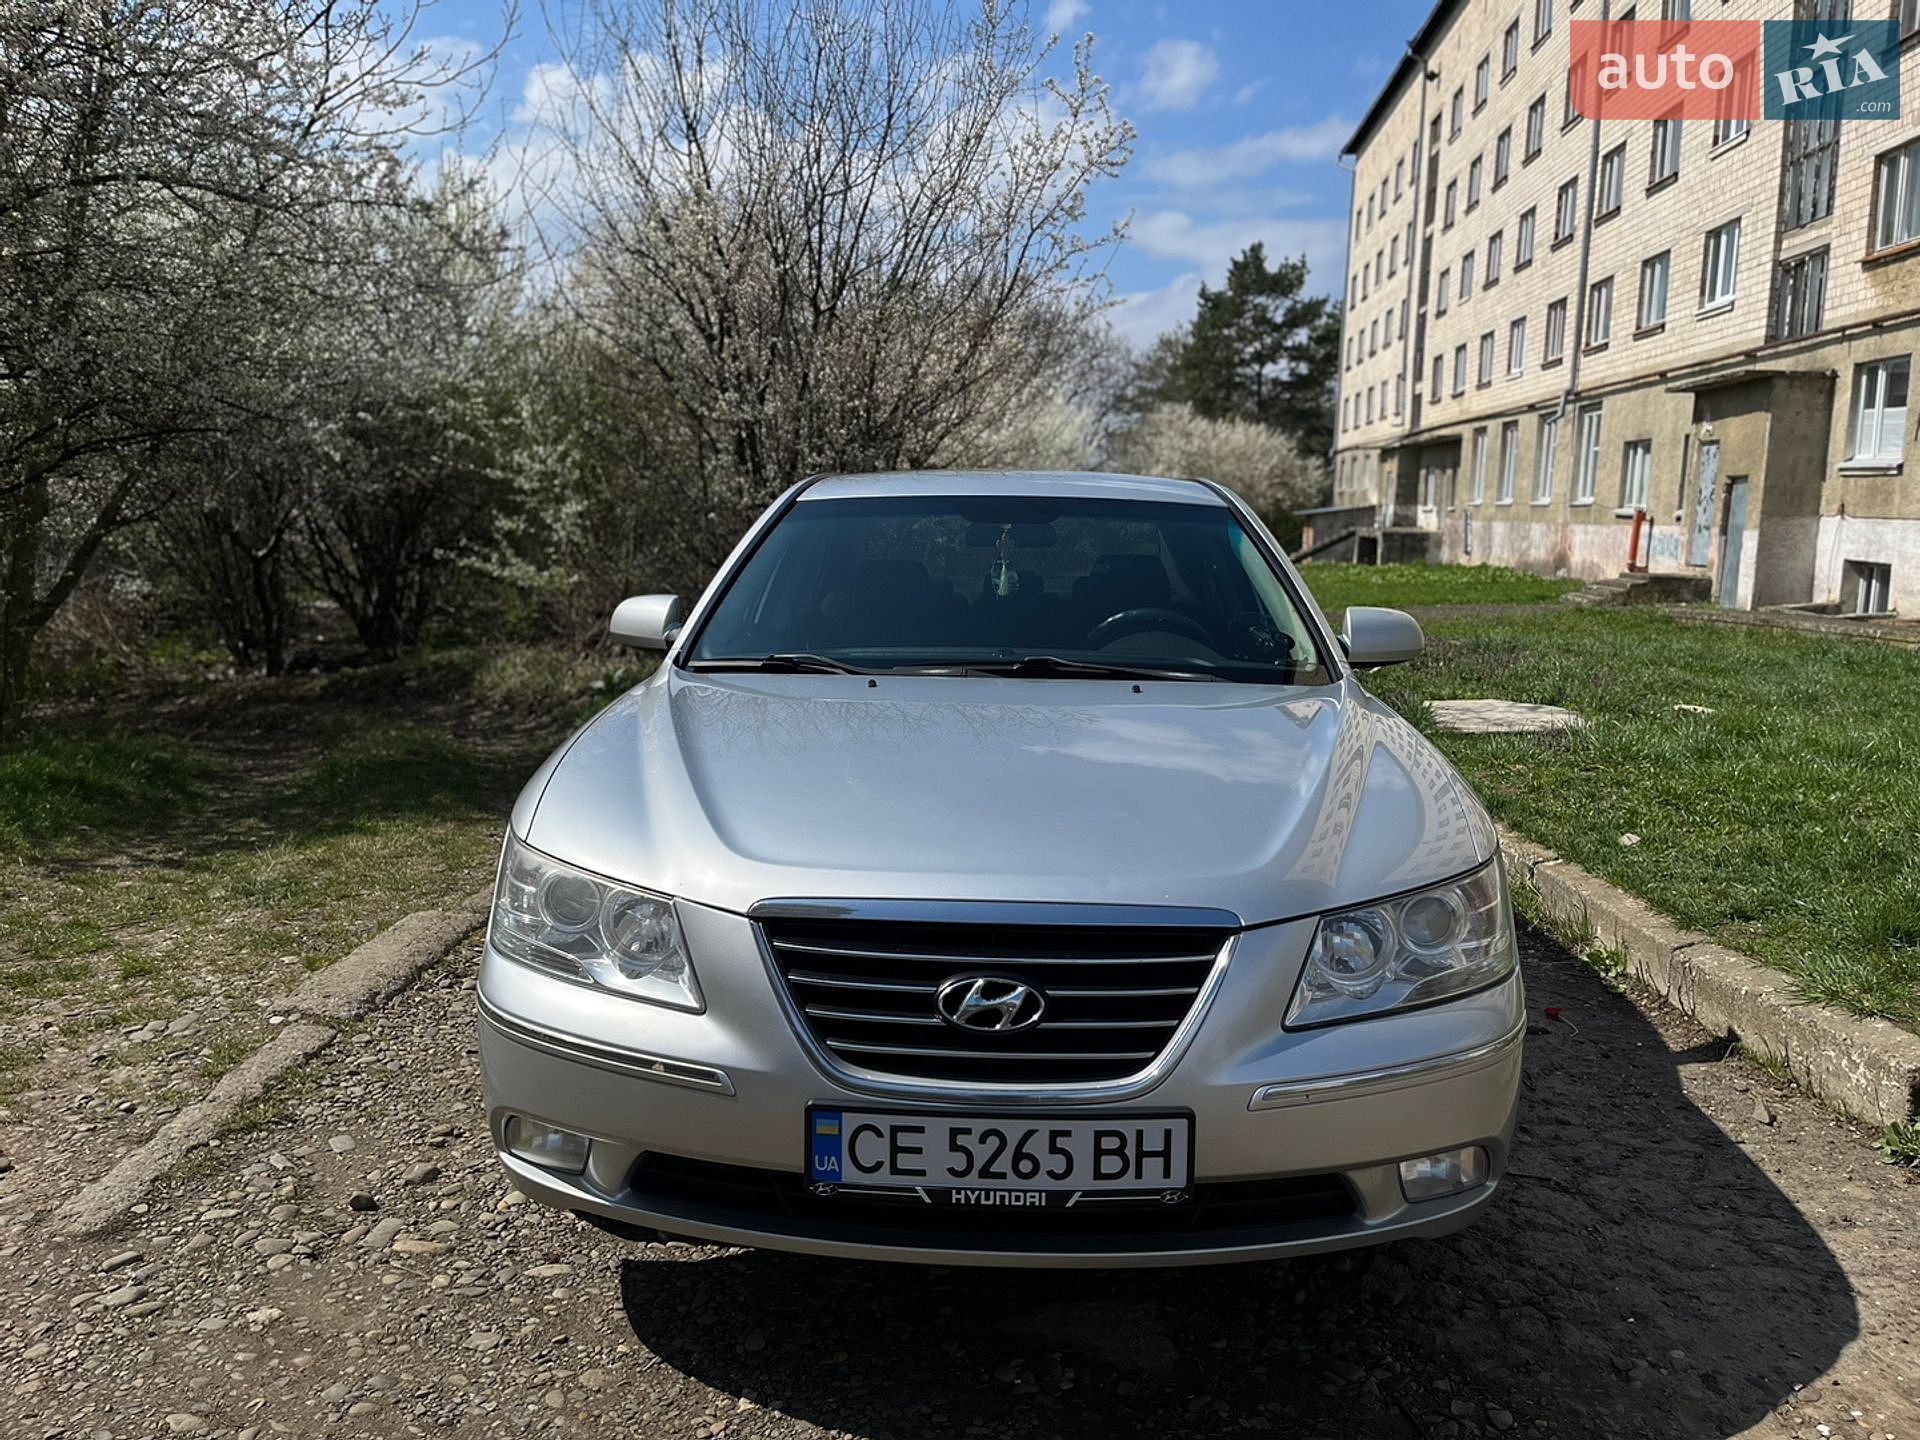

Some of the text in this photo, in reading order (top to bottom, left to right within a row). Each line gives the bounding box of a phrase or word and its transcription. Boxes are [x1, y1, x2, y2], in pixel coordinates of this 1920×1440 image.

[847, 1123, 1173, 1181] CE 5265 BH
[815, 1155, 840, 1172] UA
[951, 1190, 1047, 1207] HYUNDAI
